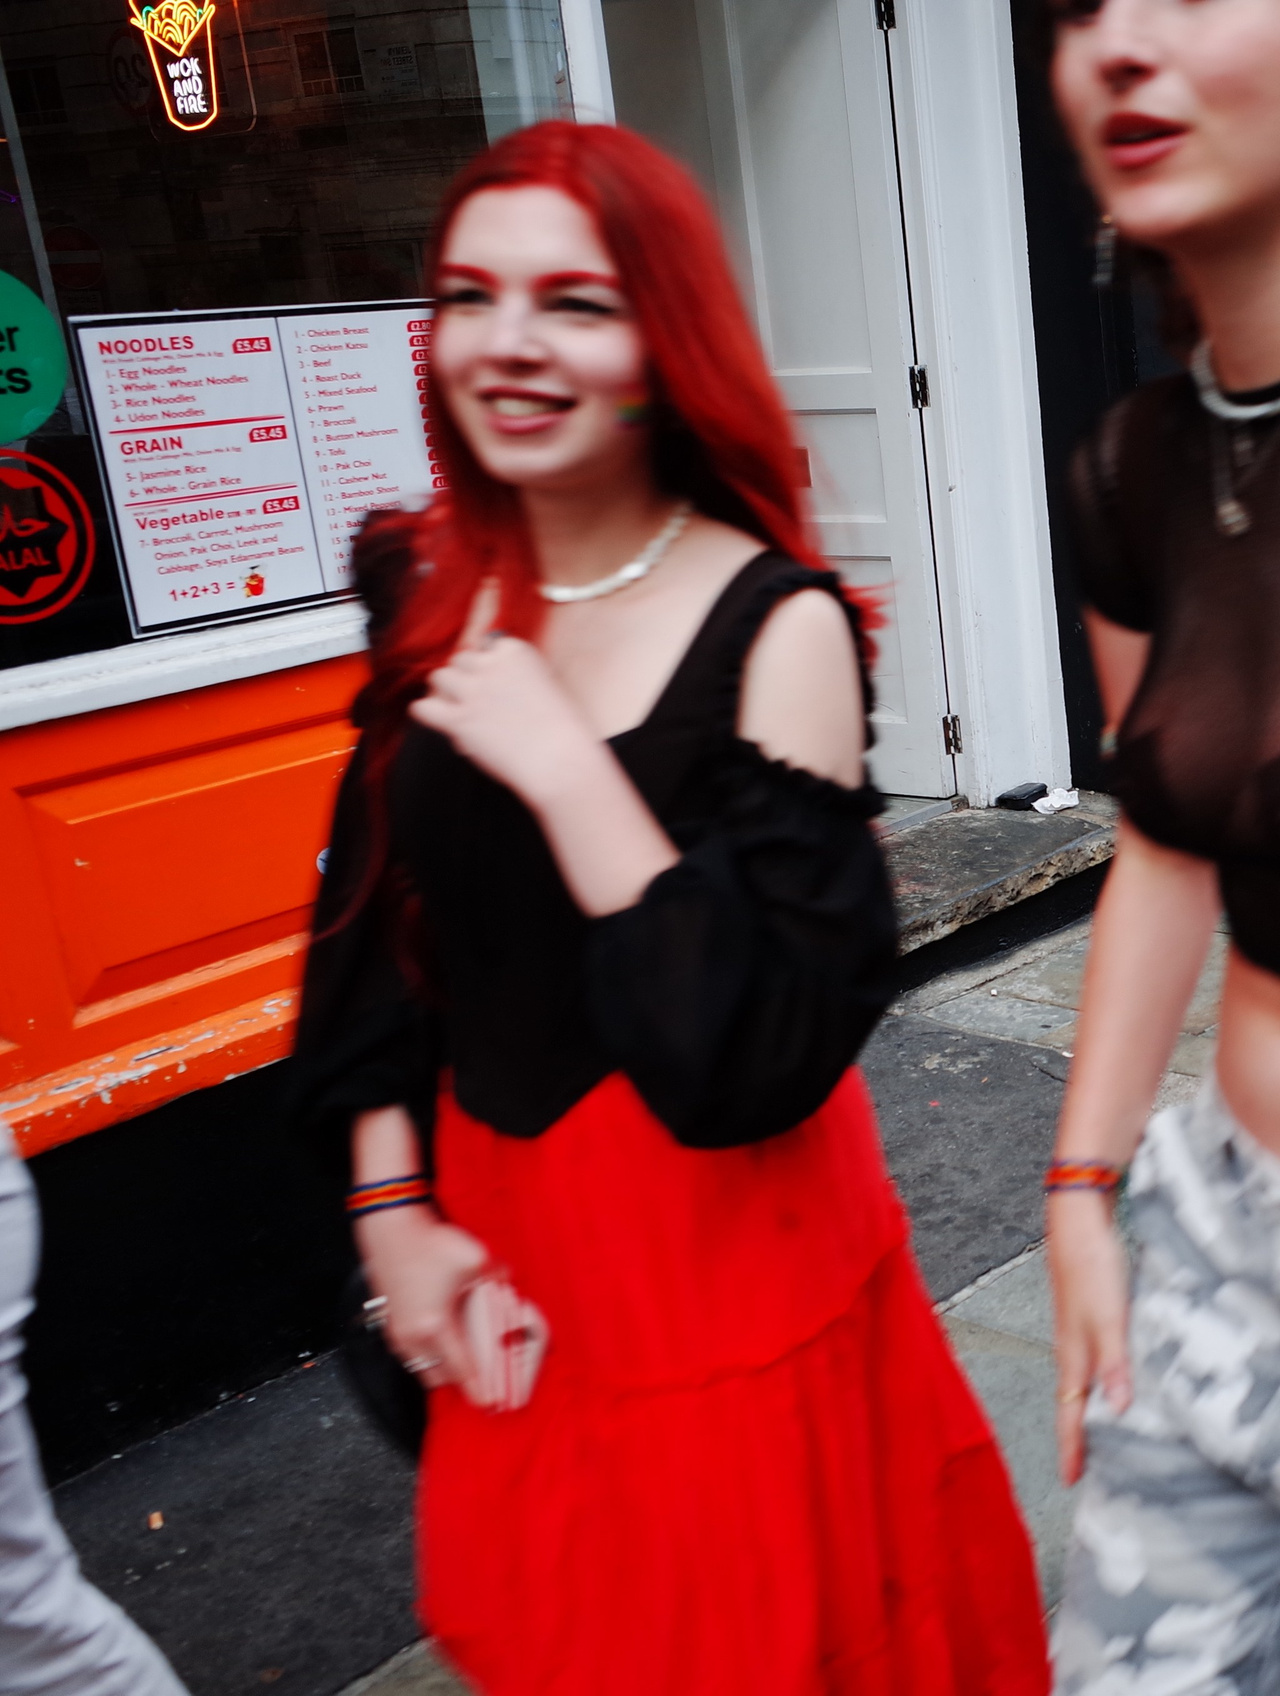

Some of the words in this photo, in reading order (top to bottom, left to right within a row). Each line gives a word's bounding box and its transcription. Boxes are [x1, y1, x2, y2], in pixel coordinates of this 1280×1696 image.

[166, 57, 202, 78] WOK
[173, 75, 203, 96] AND
[176, 94, 208, 114] FIRE
[308, 329, 340, 337] Chicken
[98, 336, 194, 355] NOODLES
[236, 340, 267, 351] £5.45
[413, 337, 429, 345] £2.9
[311, 344, 342, 352] Chicken
[313, 359, 331, 367] Beef
[120, 369, 139, 380] Egg
[142, 365, 187, 375] Noodles
[340, 372, 361, 380] Duck
[122, 383, 157, 391] Whole
[168, 379, 202, 387] Wheat
[206, 375, 248, 385] Noodles
[345, 385, 377, 394] Seafood
[125, 399, 148, 407] Rice
[152, 395, 196, 404] Noodles
[128, 413, 158, 422] Udon
[162, 408, 205, 418] Noodles
[323, 417, 356, 427] Broccoli
[253, 427, 283, 440] £5.45
[356, 429, 398, 438] Mushroom
[120, 436, 183, 455] GRAIN
[353, 459, 371, 468] Choi
[140, 469, 181, 481] Jasmine
[185, 465, 207, 474] Rice
[143, 486, 177, 495] Whole
[188, 480, 216, 490] Grain
[220, 477, 241, 485] Rice
[339, 476, 369, 485] Cashew
[341, 490, 374, 499] Bamboo
[376, 486, 399, 494] Shoot
[266, 500, 296, 511] £5.45
[136, 509, 224, 530] Vegetable
[346, 520, 363, 528] Bab
[235, 521, 284, 532] Mushroom
[238, 539, 258, 548] Leek
[262, 535, 278, 543] and
[206, 559, 228, 567] Soya
[231, 551, 274, 563] Edamame
[278, 546, 304, 555] Beans
[170, 582, 220, 601] 1+2+3
